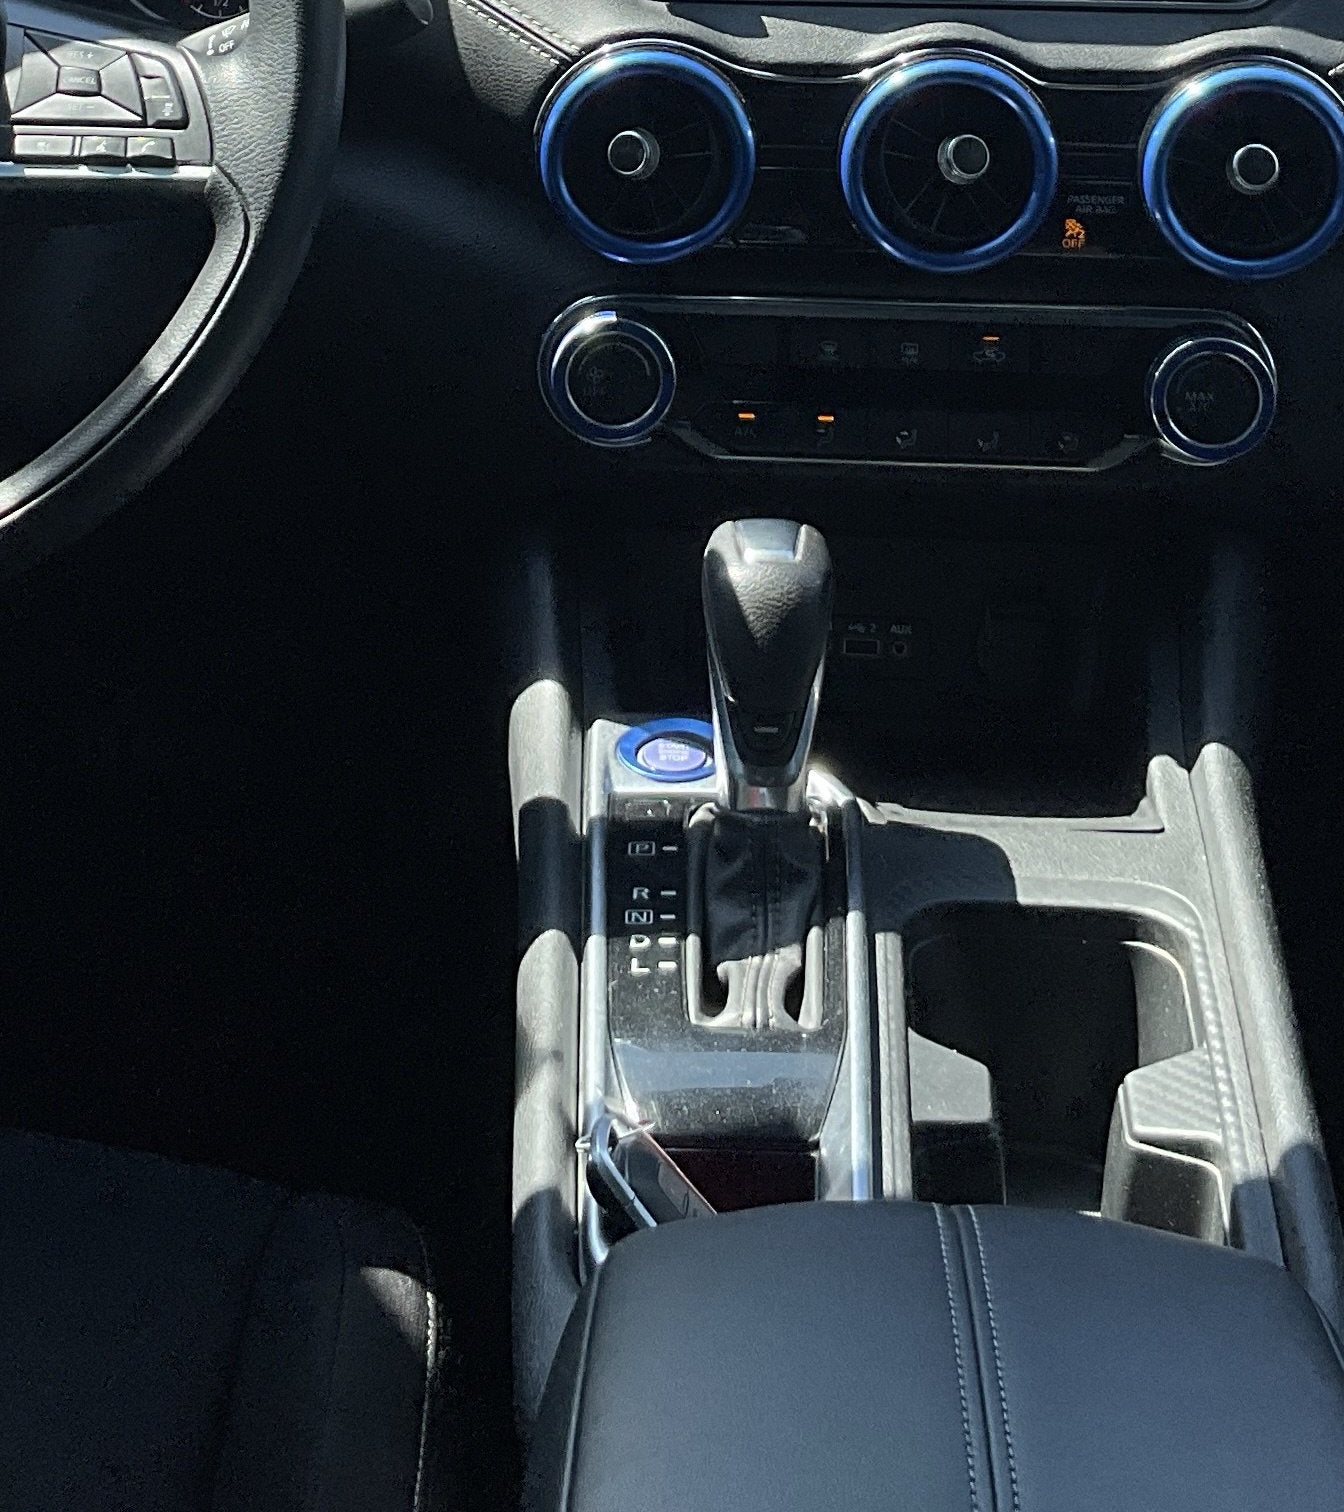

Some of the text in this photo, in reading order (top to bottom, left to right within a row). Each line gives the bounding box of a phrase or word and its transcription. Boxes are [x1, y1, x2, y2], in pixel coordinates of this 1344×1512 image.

[218, 40, 235, 53] OFF
[1062, 238, 1086, 249] OFF
[636, 844, 650, 854] P
[632, 887, 649, 900] R
[632, 911, 647, 923] N
[630, 935, 651, 951] D
[631, 957, 650, 975] L
